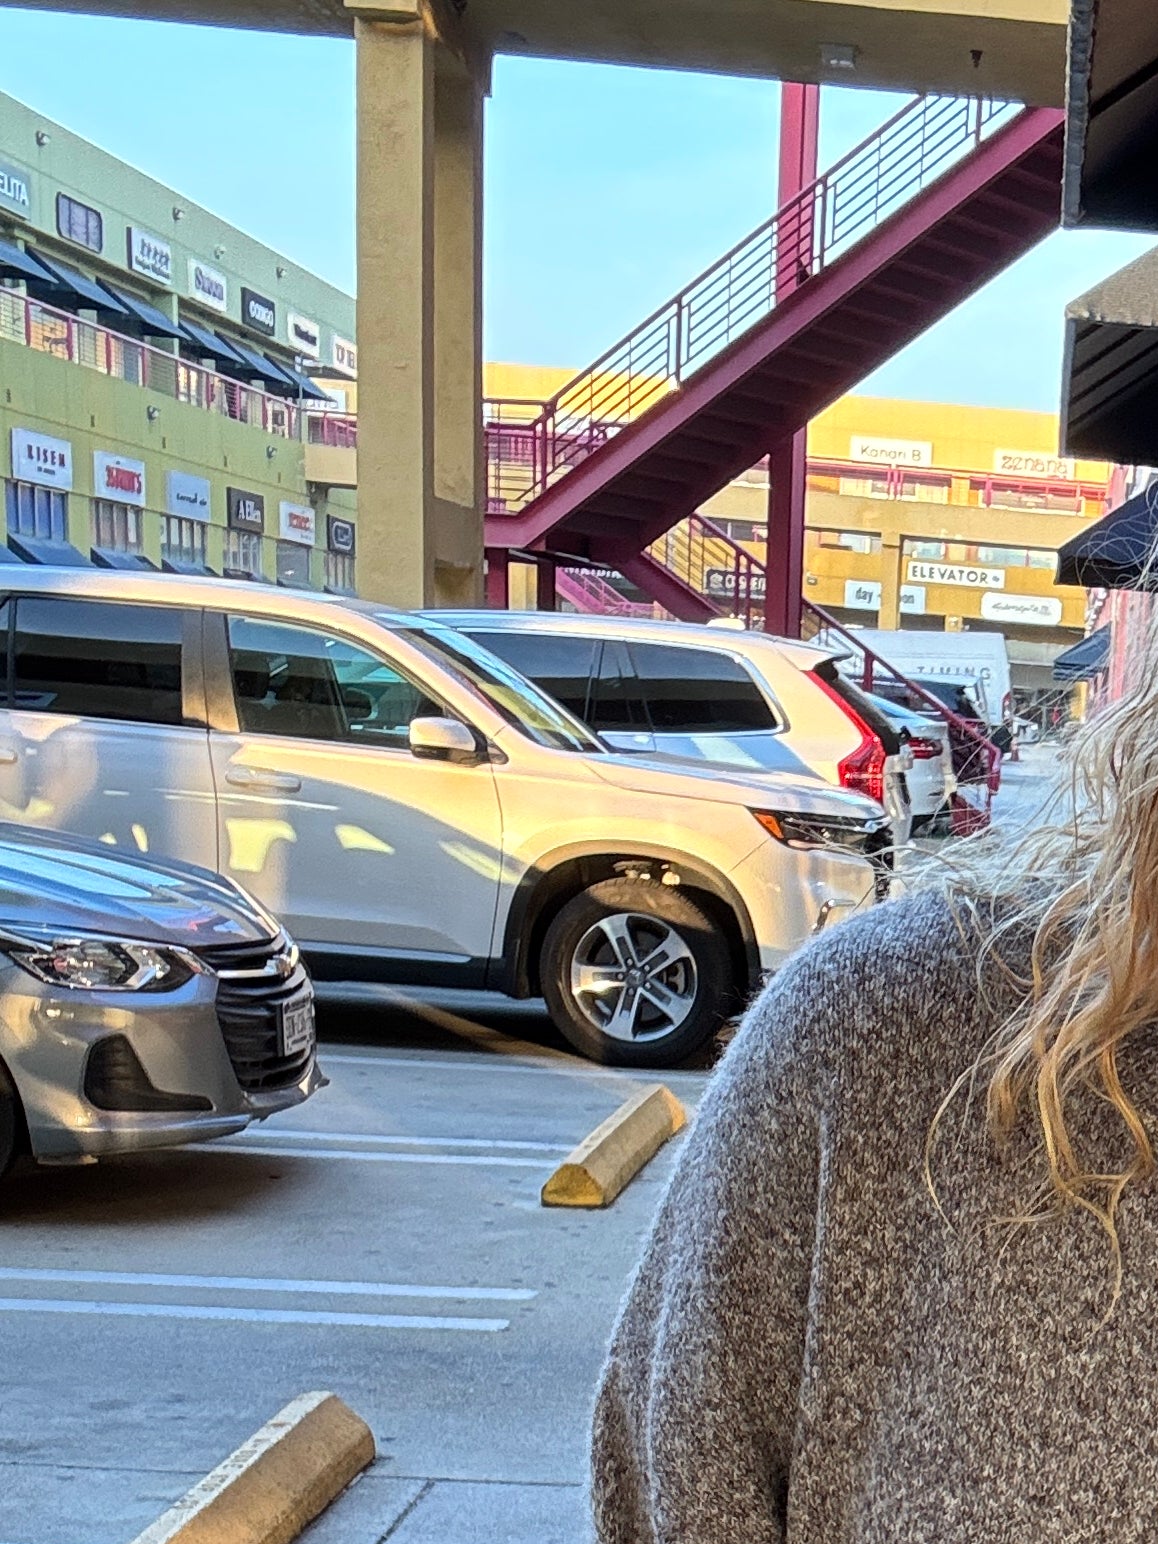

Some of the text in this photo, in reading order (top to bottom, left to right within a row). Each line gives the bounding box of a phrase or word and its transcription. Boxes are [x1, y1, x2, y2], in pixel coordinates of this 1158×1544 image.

[861, 444, 907, 460] Kanari
[912, 565, 989, 584] ELEVATOR
[856, 586, 874, 604] day
